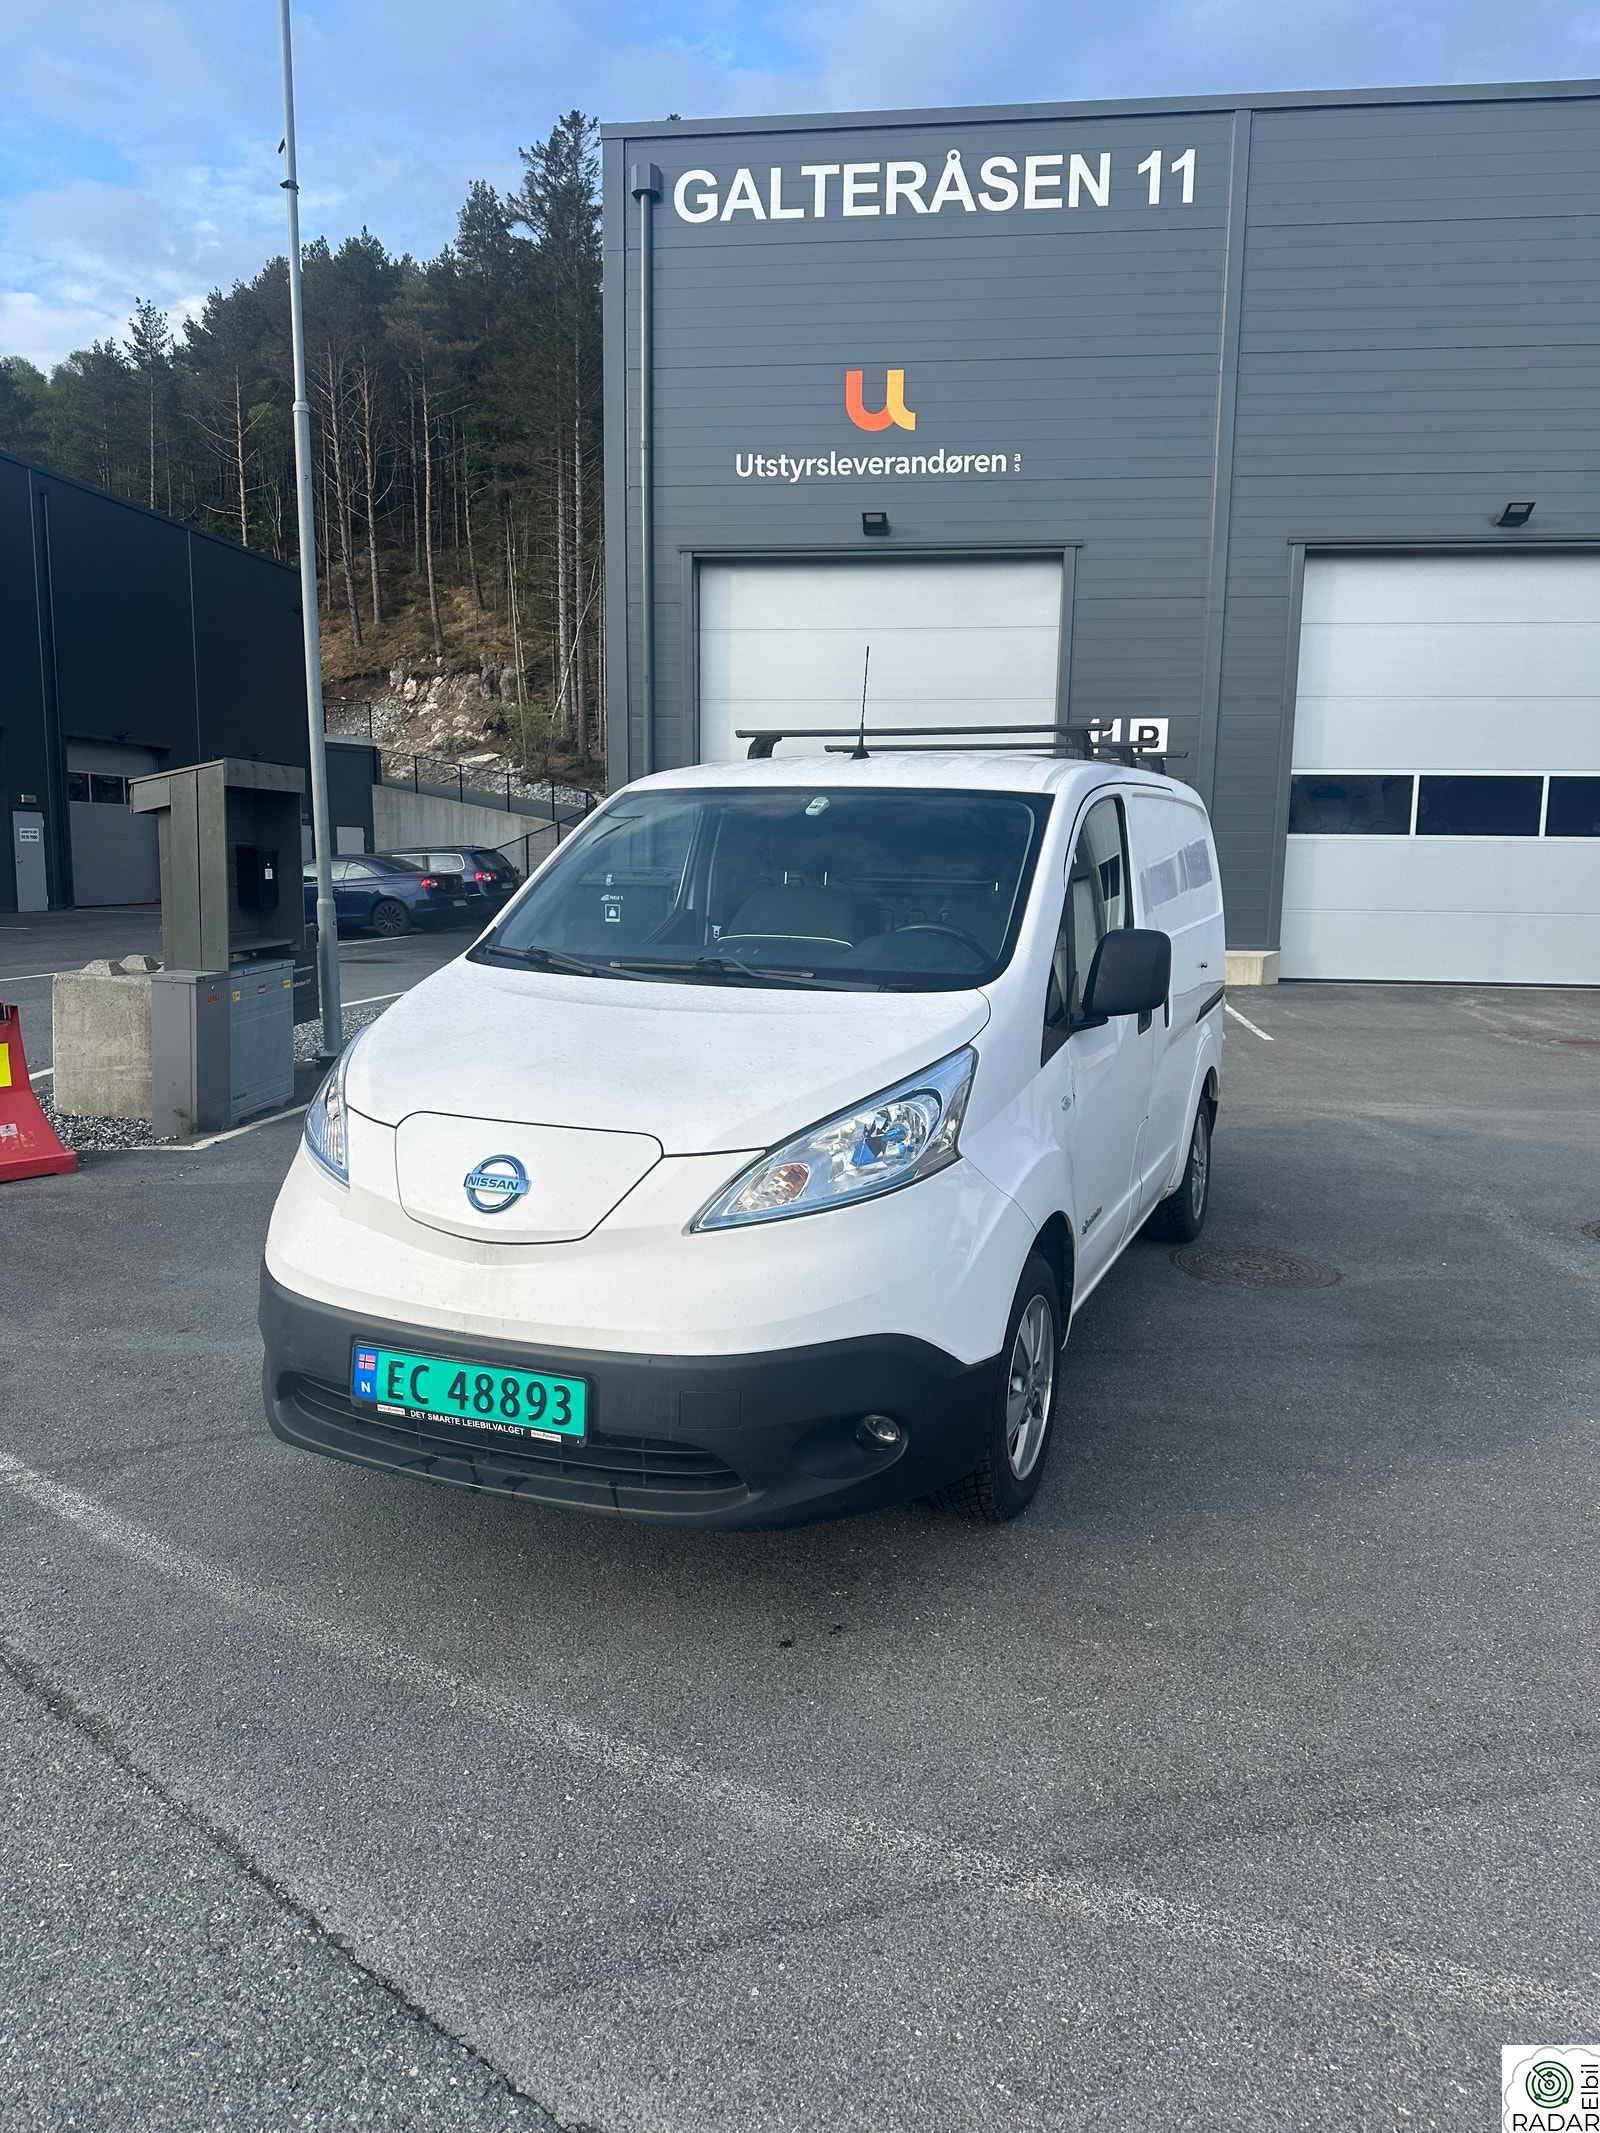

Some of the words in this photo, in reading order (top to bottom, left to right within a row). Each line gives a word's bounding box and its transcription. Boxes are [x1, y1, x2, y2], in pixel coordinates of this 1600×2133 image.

[673, 149, 1112, 224] GALTERÅSEN
[1136, 148, 1196, 205] 11
[735, 448, 1007, 483] Utstyrsleverandøren
[467, 1176, 519, 1191] NISSAN
[360, 1381, 371, 1393] N
[387, 1359, 430, 1405] EC
[447, 1370, 572, 1426] 48893
[410, 1410, 426, 1420] DET
[427, 1413, 461, 1425] SMARTE
[462, 1420, 525, 1436] LEIEBILVALGET
